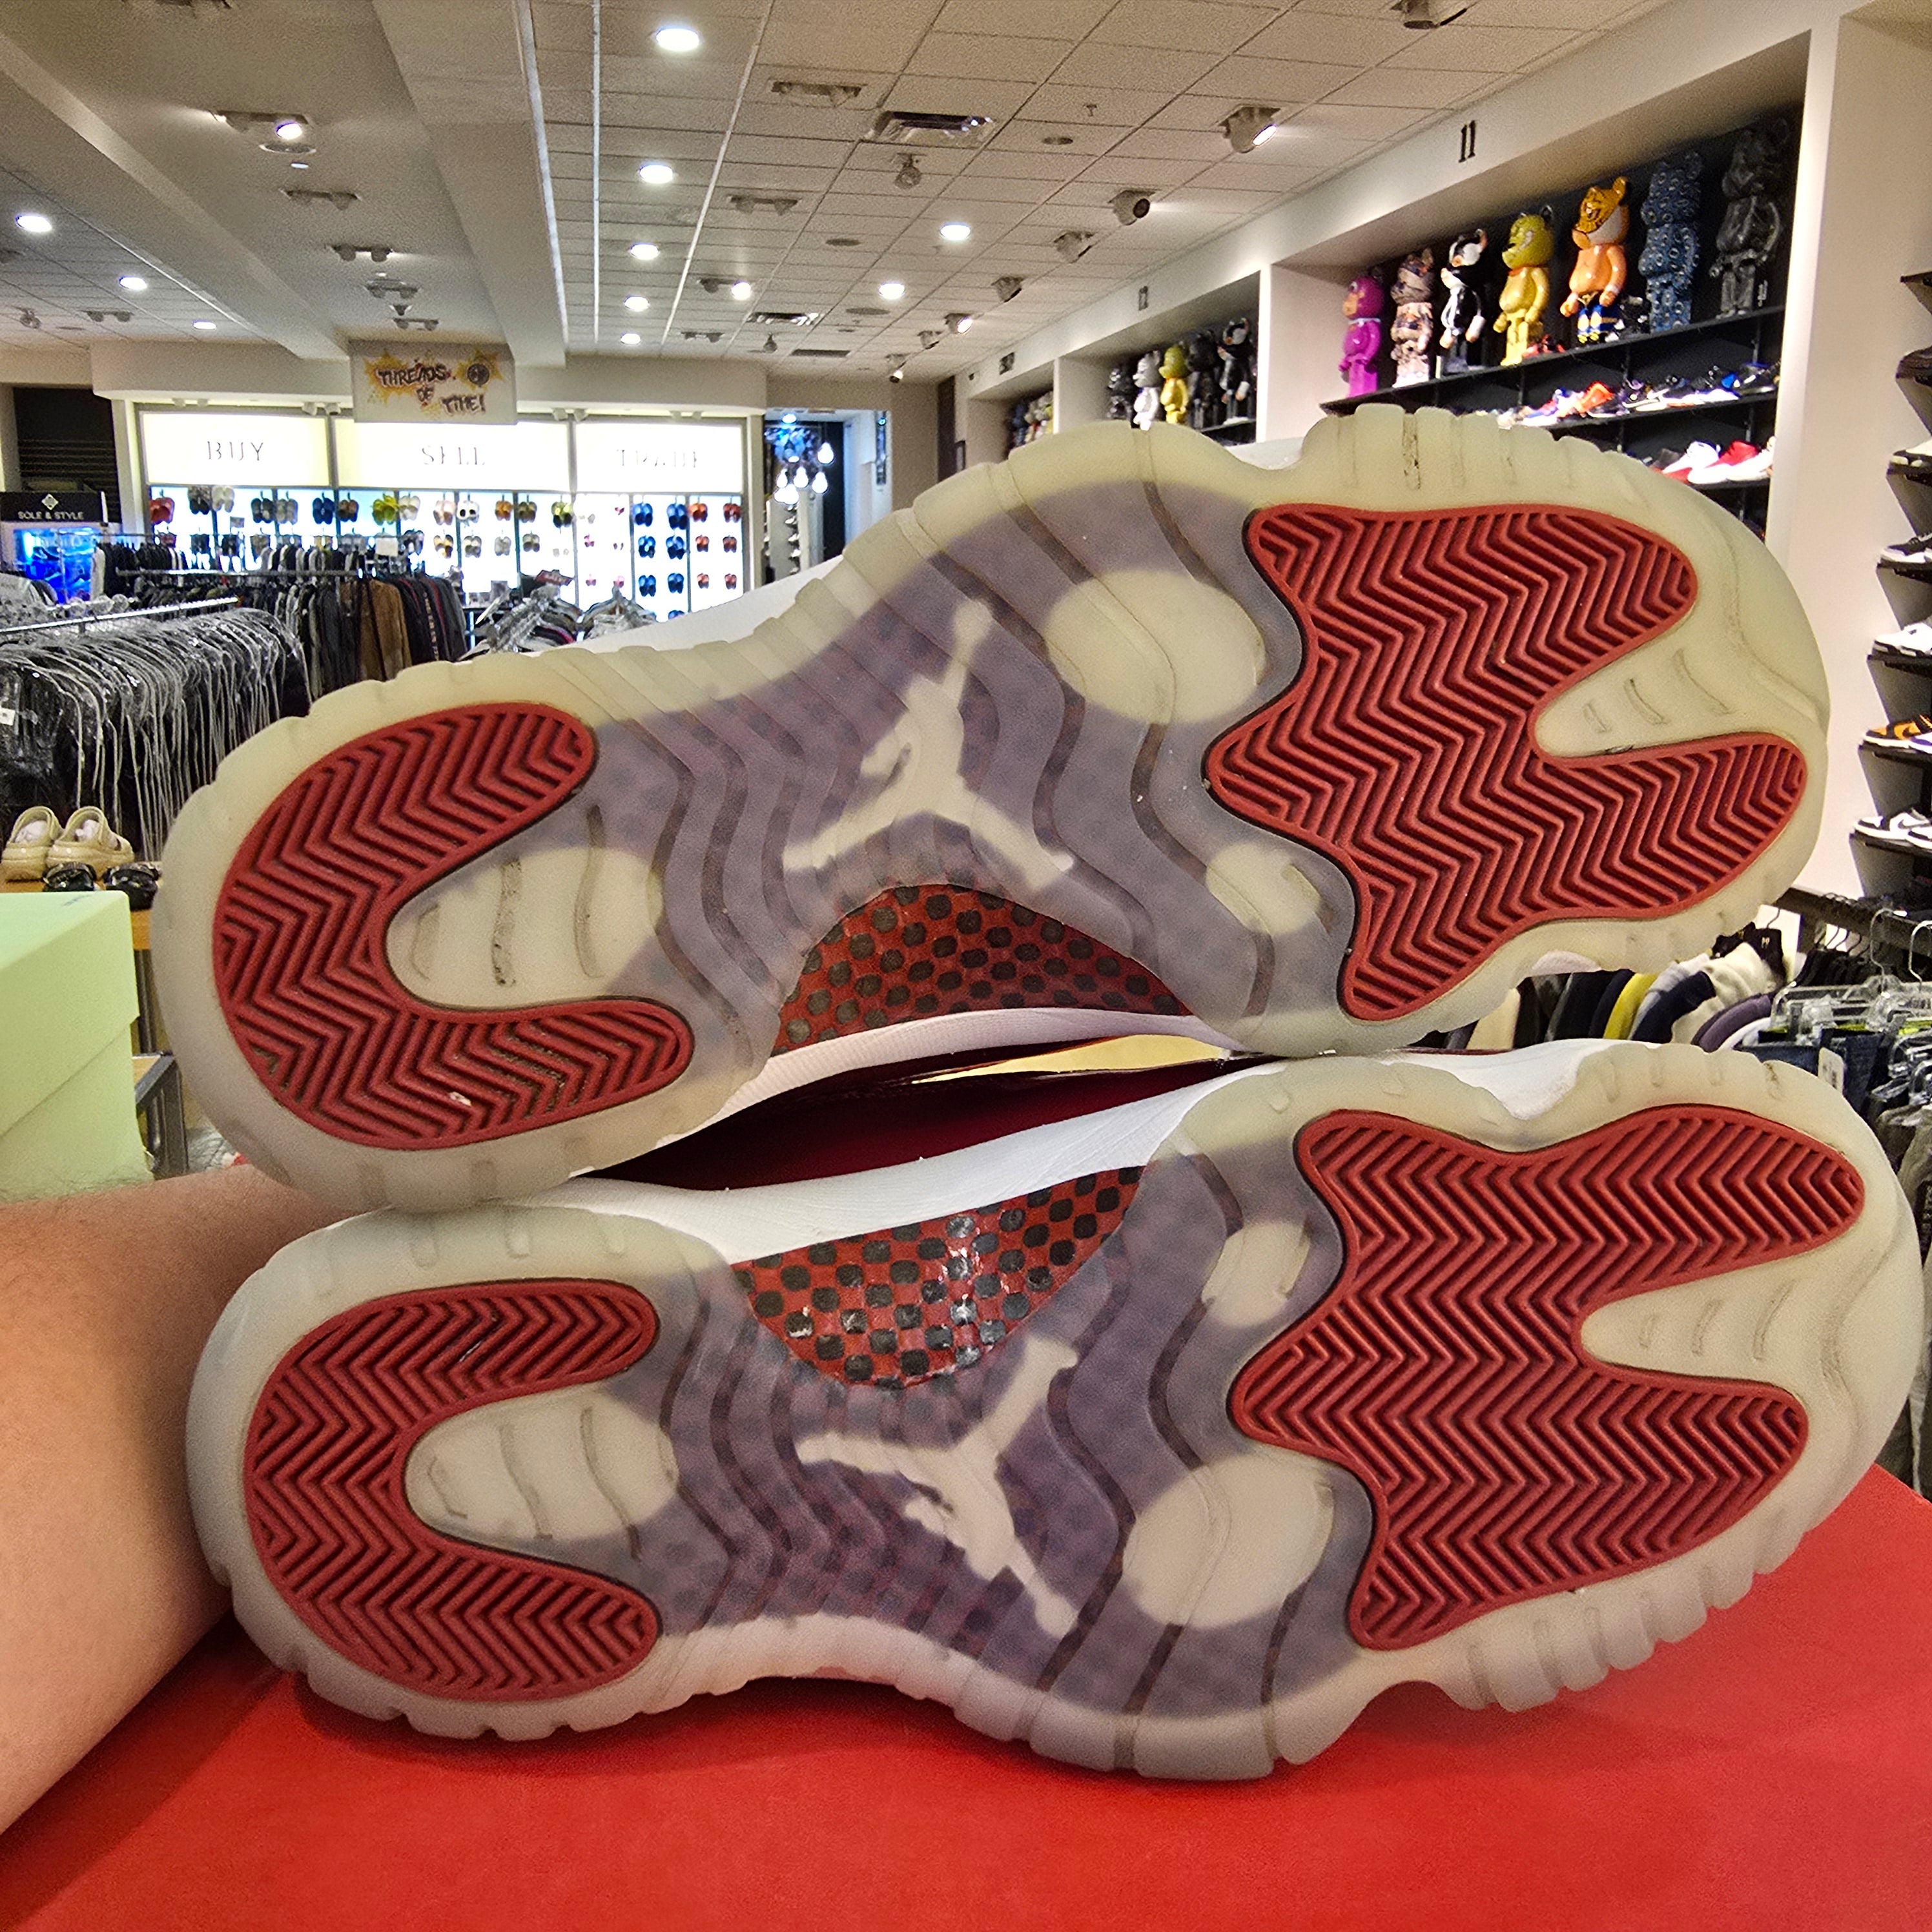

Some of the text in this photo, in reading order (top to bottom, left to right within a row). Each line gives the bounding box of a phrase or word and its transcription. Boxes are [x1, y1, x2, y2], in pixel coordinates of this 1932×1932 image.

[378, 362, 447, 386] THREADS
[207, 440, 263, 461] BUY
[17, 511, 42, 520] SOLE
[54, 511, 84, 520] STYLE
